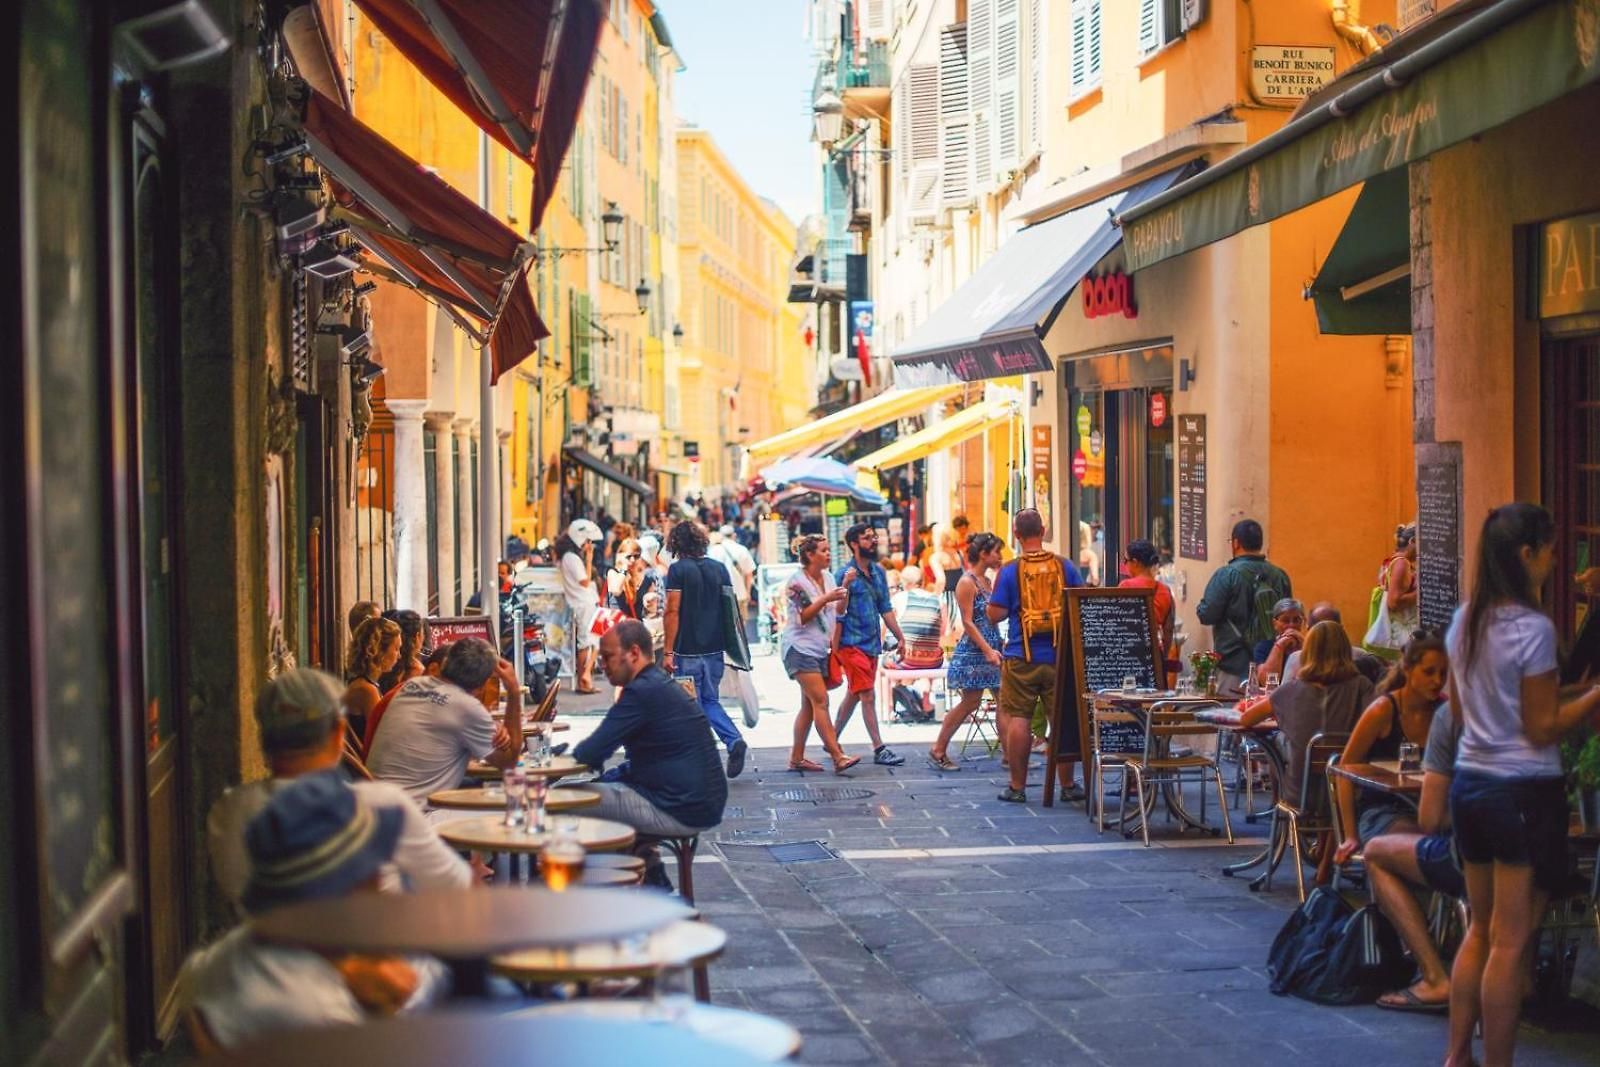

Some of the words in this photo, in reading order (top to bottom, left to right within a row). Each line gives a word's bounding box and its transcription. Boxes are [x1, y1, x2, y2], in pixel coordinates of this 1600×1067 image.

[1283, 50, 1304, 59] RUE
[1295, 61, 1333, 70] BUNICO
[1265, 75, 1322, 84] CARRIERA
[1267, 86, 1281, 95] DE
